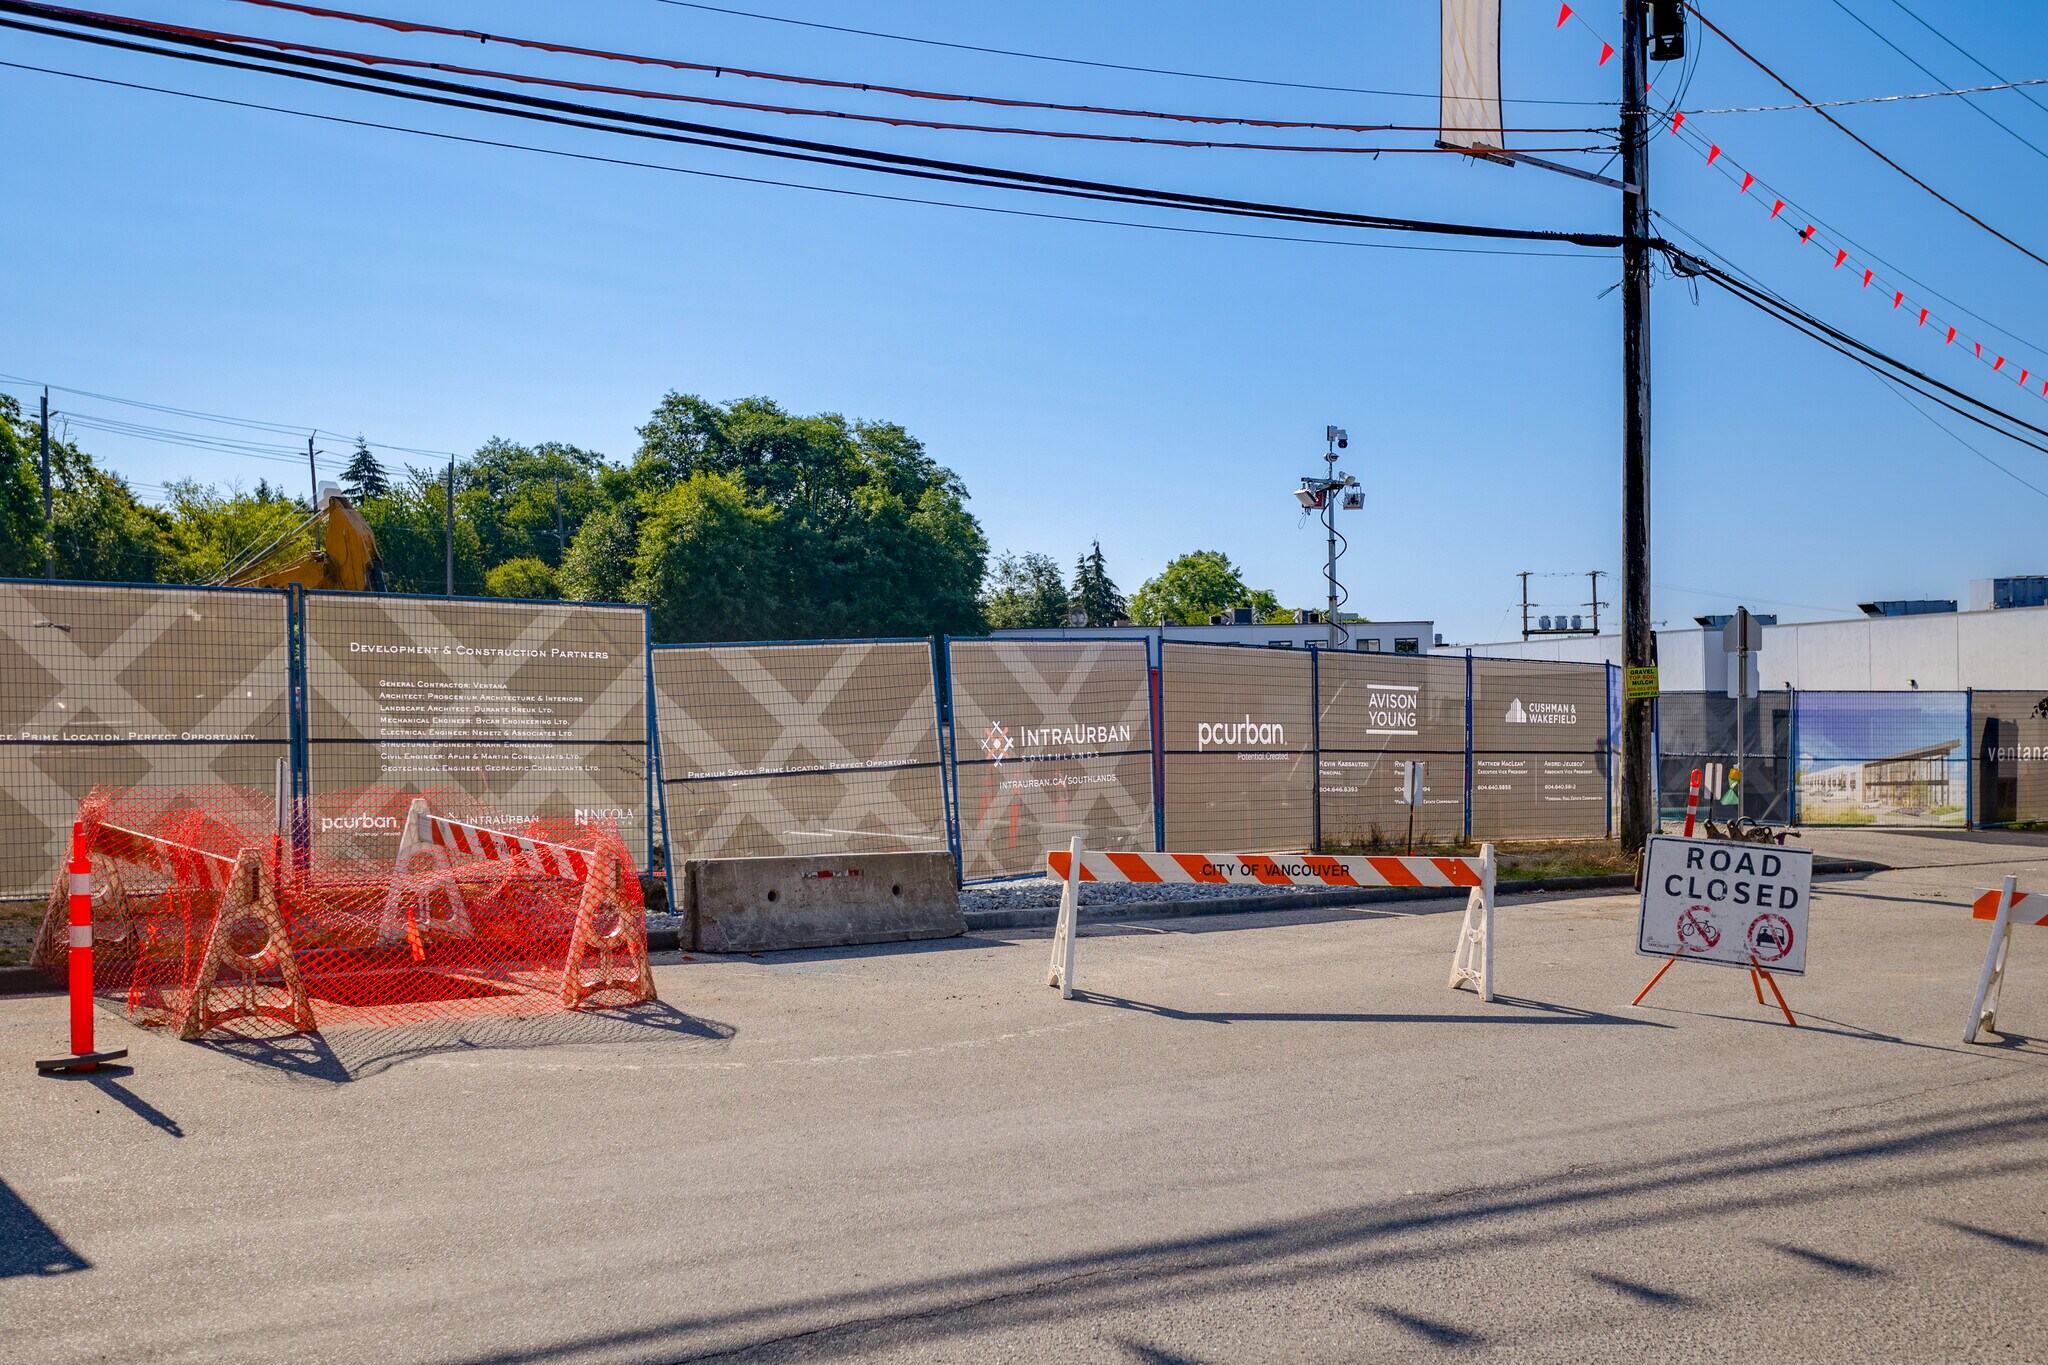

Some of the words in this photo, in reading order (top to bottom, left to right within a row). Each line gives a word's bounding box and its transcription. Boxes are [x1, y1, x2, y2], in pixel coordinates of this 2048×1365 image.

[350, 642, 439, 655] DEVELOPMENT
[443, 646, 452, 655] &
[456, 645, 546, 657] CONSTRUCTION
[551, 648, 609, 660] PARTNERS
[379, 680, 415, 688] GENERAL
[417, 680, 471, 689] CONTRACTOR:
[473, 682, 508, 690] VENTANA
[379, 692, 425, 700] ARCHITECT:
[427, 692, 477, 701] PROSCENIUM
[480, 694, 536, 702] ARCHITECTURE
[537, 694, 543, 702] &
[545, 695, 583, 703] INTERIORS
[1368, 693, 1417, 709] AVISON
[380, 704, 425, 712] LANDSCAPE
[427, 704, 472, 713] ARCHITECT:
[1529, 703, 1569, 713] CUSHMAN
[1570, 704, 1576, 713] &
[380, 716, 430, 724] MECHANICAL
[432, 716, 473, 724] ENGINEER:
[502, 717, 552, 725] ENGINEERING
[1368, 711, 1417, 727] YOUNG
[1529, 713, 1577, 724] WAKEFIELD
[22, 732, 59, 741] PRIME
[63, 732, 124, 741] LOCATION.
[129, 732, 177, 740] PERFECT
[181, 731, 258, 741] OPPORTUNITY.
[380, 728, 426, 736] ELECTRICAL
[429, 728, 470, 736] ENGINEER:
[503, 729, 509, 737] &
[1021, 724, 1130, 747] INTRAURBAN
[1021, 751, 1100, 763] SOUTHLANDS
[1988, 743, 2048, 762] ventana
[380, 764, 440, 772] GEOTECHNICAL
[442, 764, 482, 772] ENGINEER:
[687, 771, 725, 780] PREMIUM
[727, 768, 756, 777] SPACE.
[758, 766, 784, 775] PRIME
[785, 763, 828, 774] LOCATION.
[829, 761, 864, 770] PERFECT
[866, 758, 920, 768] OPPORTUNITY.
[591, 808, 634, 820] NICOLA
[1686, 847, 1782, 877] ROAD
[1202, 864, 1235, 876] CITY
[1240, 864, 1259, 876] OF
[1264, 864, 1350, 876] VANCOUVER
[1664, 874, 1799, 909] CLOSED
